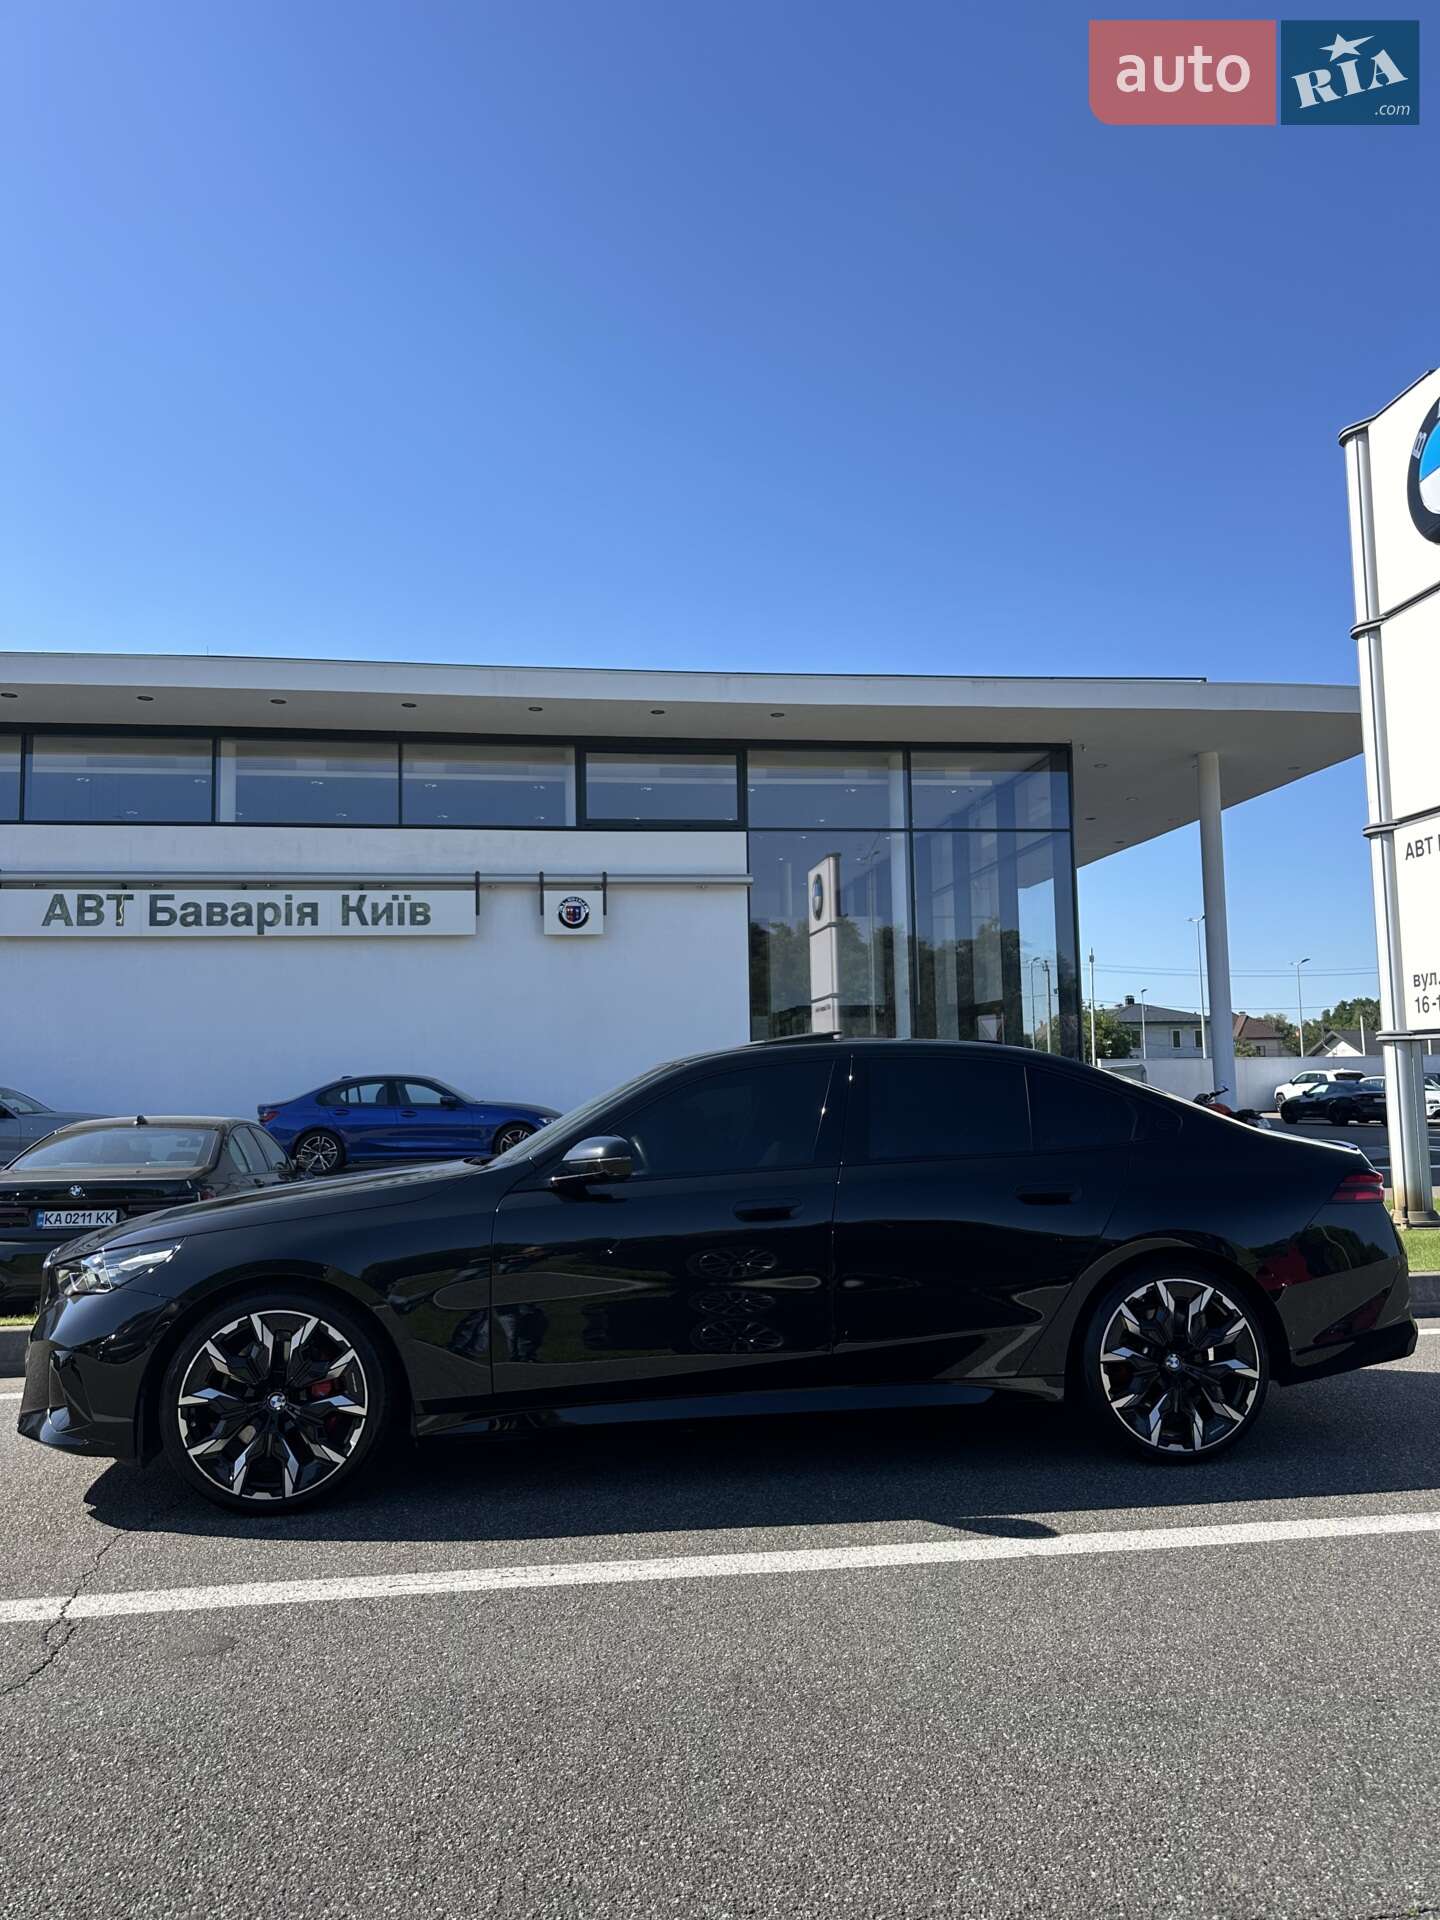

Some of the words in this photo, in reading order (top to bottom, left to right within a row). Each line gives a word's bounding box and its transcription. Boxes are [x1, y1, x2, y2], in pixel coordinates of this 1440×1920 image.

[1405, 836, 1433, 860] АВТ
[41, 894, 134, 927] АВТ
[149, 894, 319, 935] Баварія
[341, 894, 431, 927] Київ
[44, 1213, 62, 1225] KA
[65, 1212, 92, 1224] 0211
[96, 1211, 115, 1224] KK
